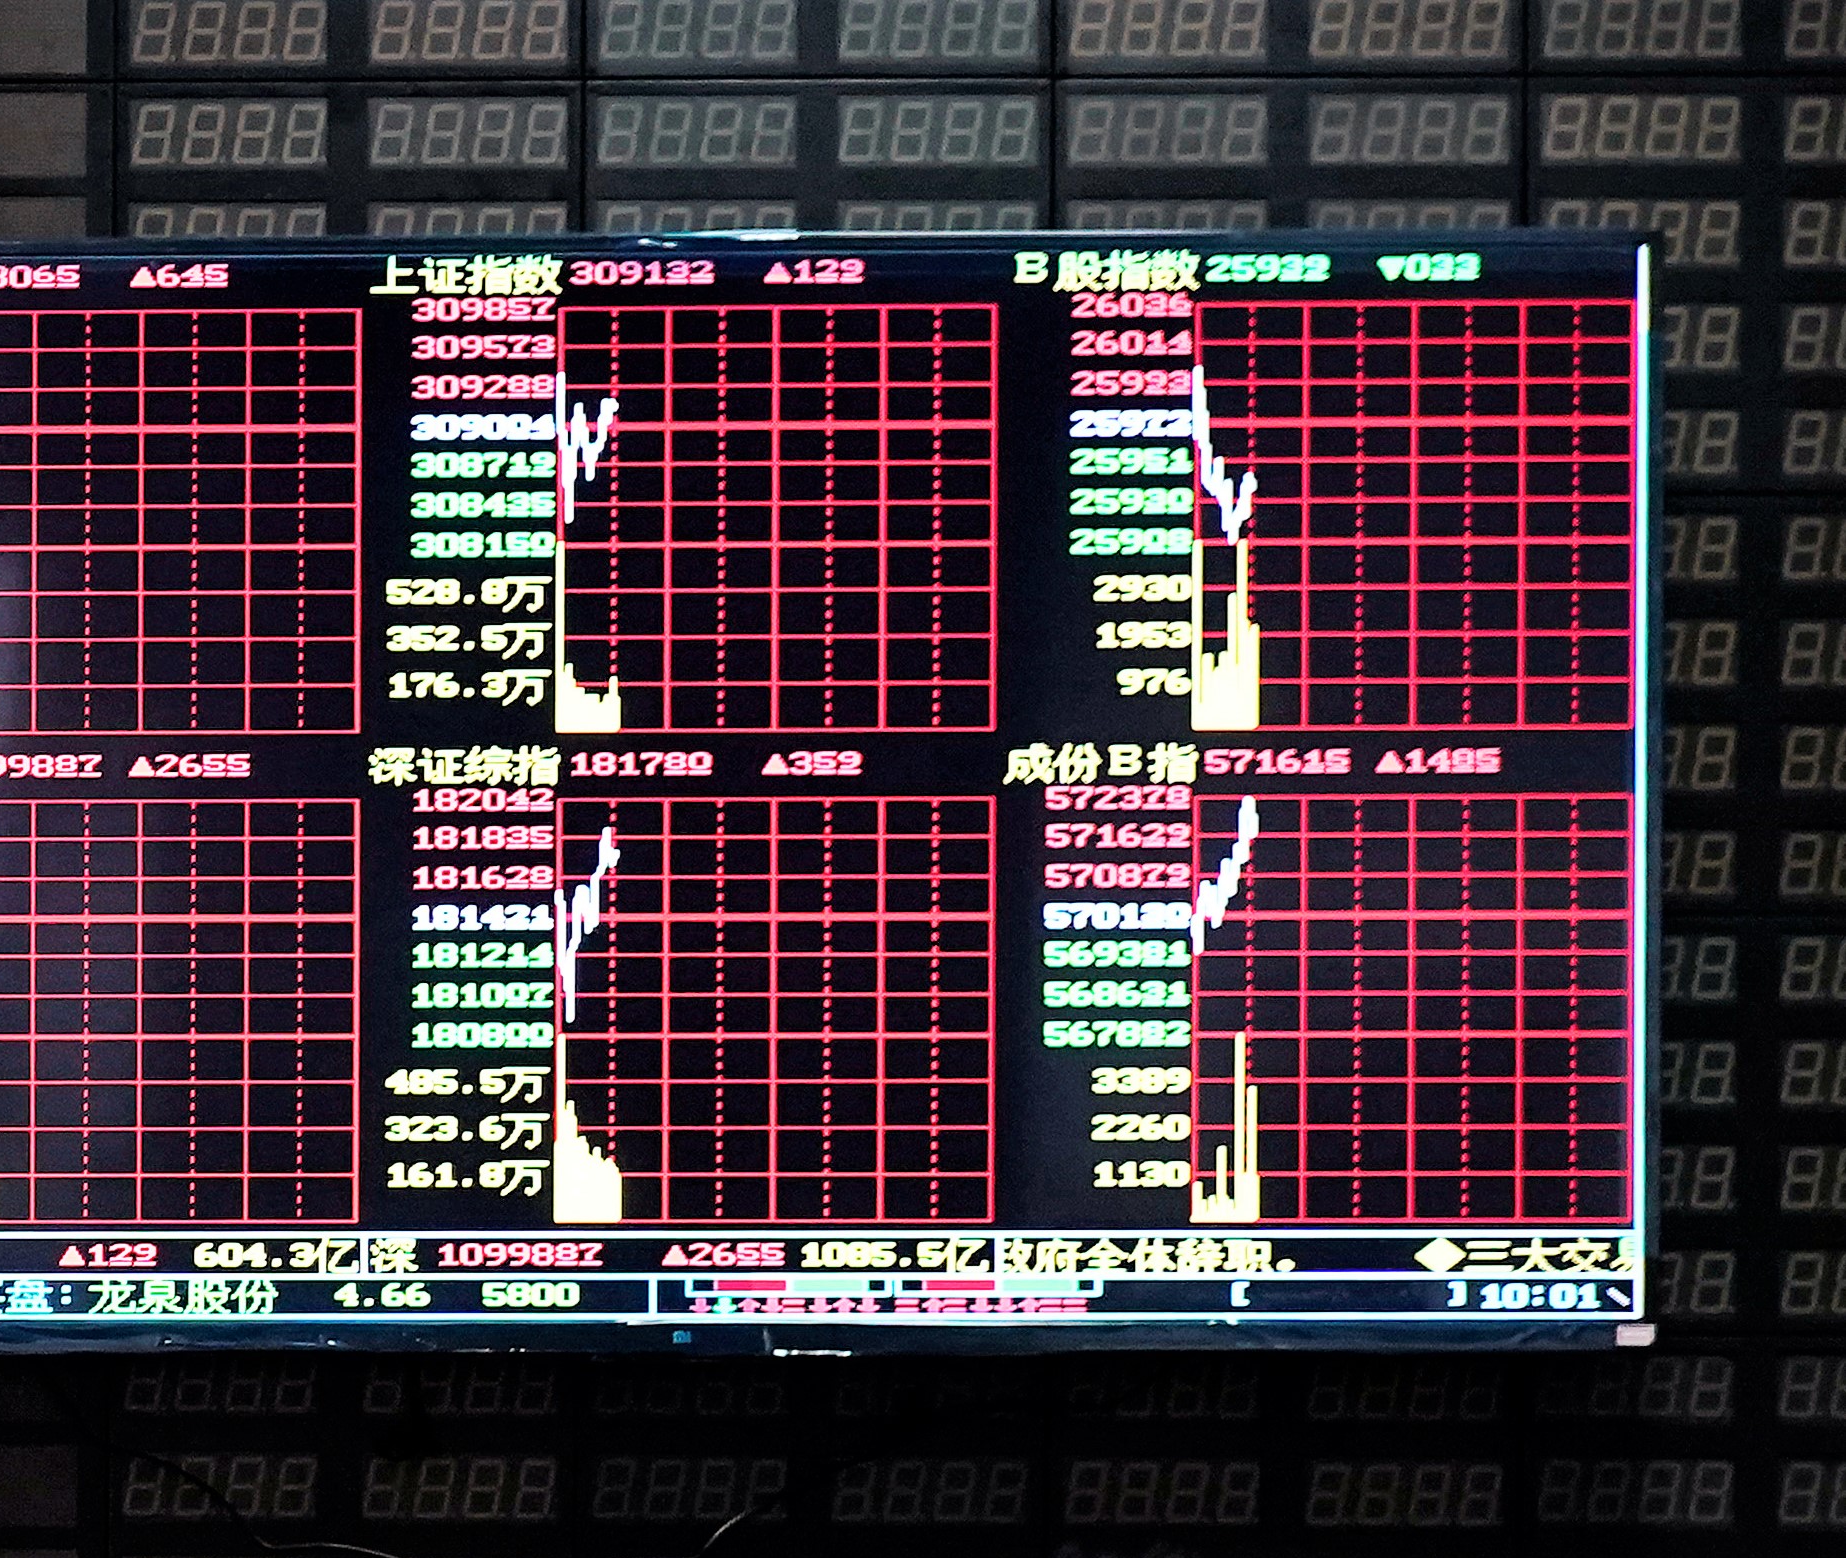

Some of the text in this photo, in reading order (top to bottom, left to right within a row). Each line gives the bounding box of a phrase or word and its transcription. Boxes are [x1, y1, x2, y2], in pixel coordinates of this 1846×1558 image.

[156, 264, 229, 288] 645
[370, 255, 866, 295] 上证指数 309132 129
[410, 298, 556, 323] 309857
[410, 375, 556, 400] 309288
[409, 452, 556, 478] 308719
[1092, 575, 1192, 602] 2930
[384, 623, 553, 660] 352.5万
[1095, 622, 1192, 648] 1953
[1116, 668, 1192, 695] 976
[155, 754, 252, 778] 2655
[368, 746, 864, 786] 深证综指 181780 359
[1003, 742, 1200, 785] 成份B指
[412, 789, 554, 813] 182042
[1091, 1114, 1192, 1140] 2260
[386, 1159, 550, 1197] 161.8万
[1092, 1160, 1192, 1187] 1130
[193, 1239, 361, 1274] 604.3亿
[87, 1280, 1601, 1314] 龙泉股份 5800 10:01
